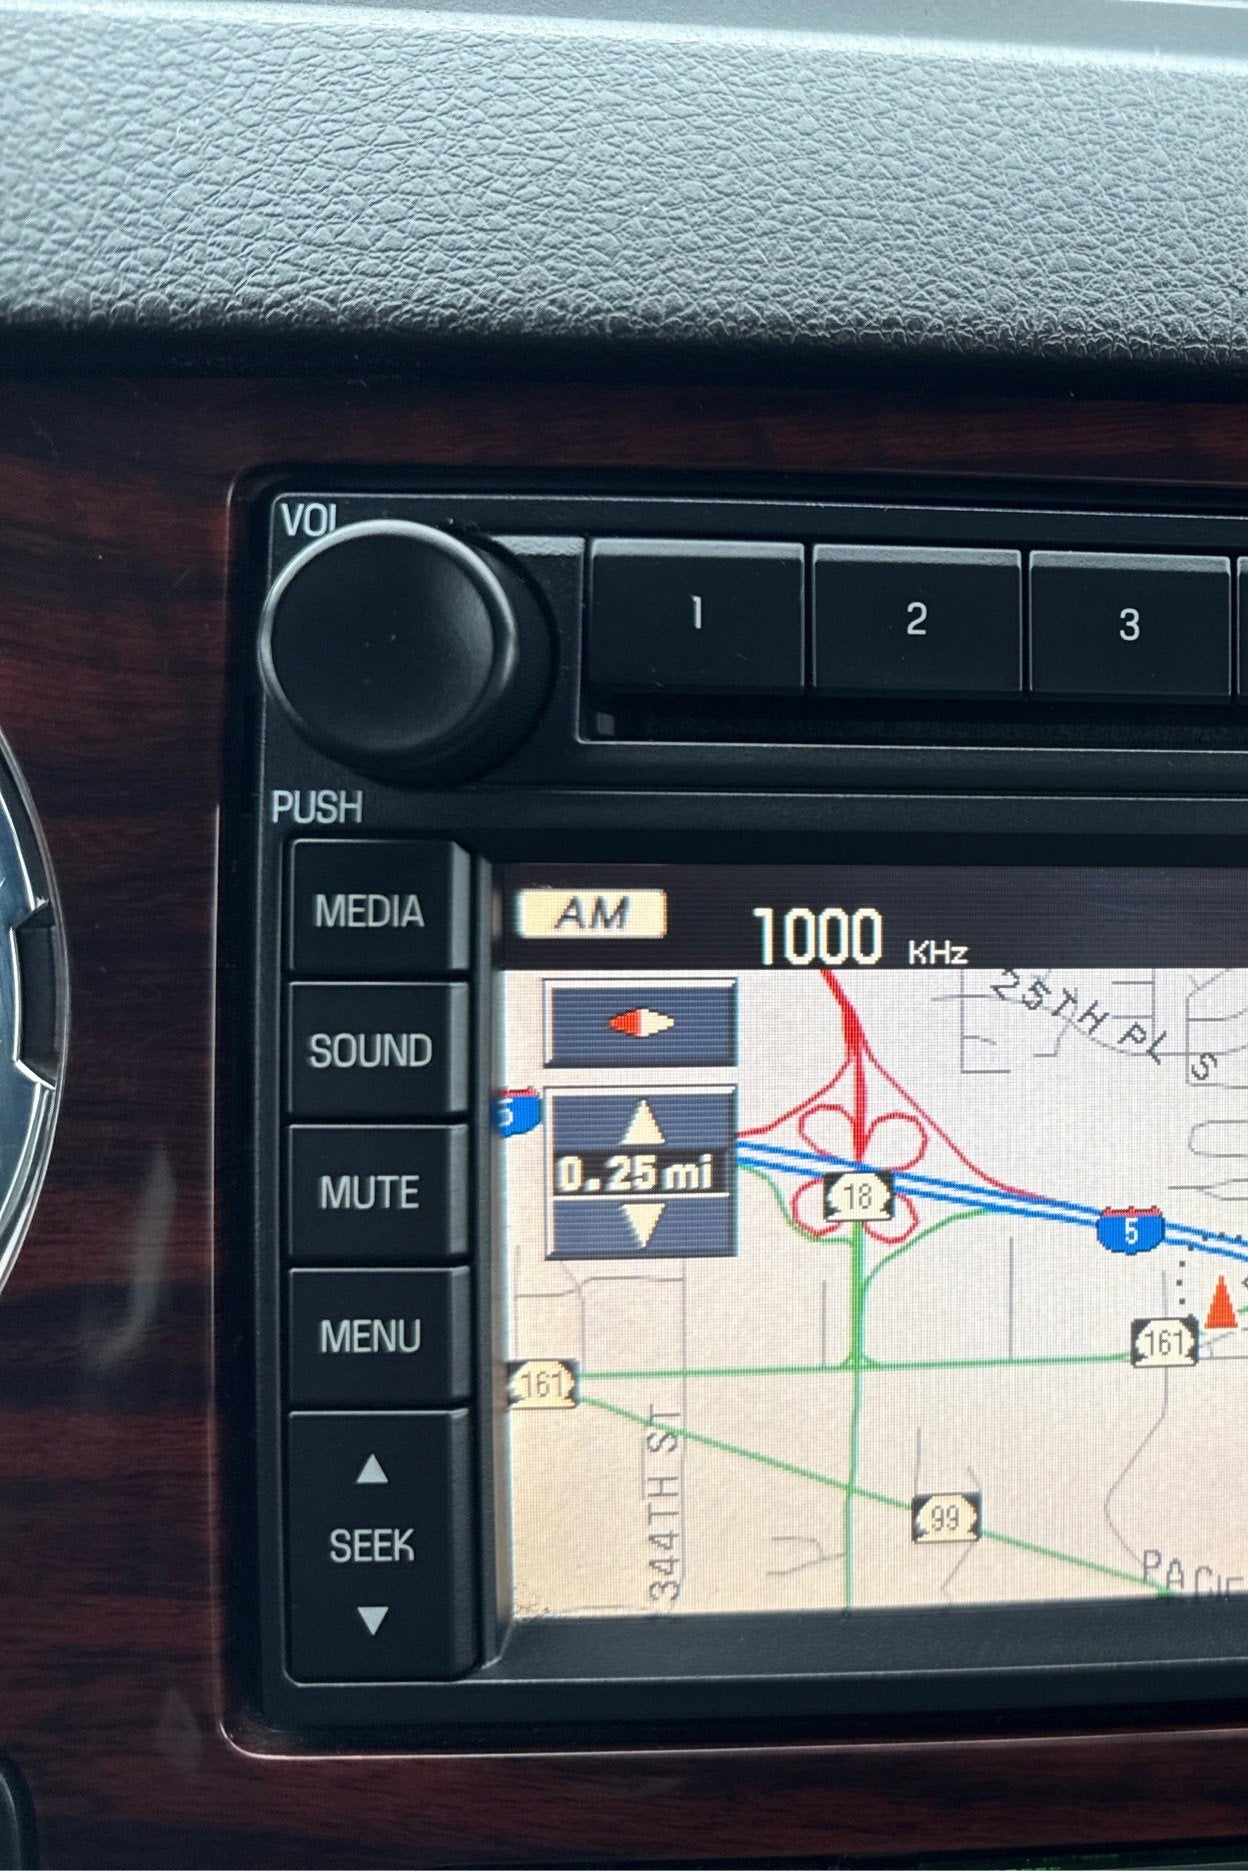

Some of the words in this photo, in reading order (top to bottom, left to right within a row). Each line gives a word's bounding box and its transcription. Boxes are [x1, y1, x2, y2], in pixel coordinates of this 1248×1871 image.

[691, 594, 702, 630] 1
[906, 601, 928, 636] 2
[1118, 607, 1141, 642] 3
[270, 790, 364, 825] PUSH
[315, 893, 426, 929] MEDIA
[554, 894, 632, 931] AM
[752, 906, 884, 966] 1000
[907, 939, 970, 966] KHz
[989, 967, 1110, 1035] 25TH
[1116, 1021, 1168, 1066] PL
[1191, 1052, 1218, 1081] S
[308, 1031, 434, 1069] SOUND
[320, 1174, 421, 1210] MUTE
[842, 1182, 873, 1210] 18
[1124, 1217, 1139, 1245] 5
[319, 1318, 422, 1355] MENU
[1144, 1330, 1186, 1357] 161
[520, 1369, 567, 1400] 161
[647, 1402, 683, 1454] ST
[930, 1505, 961, 1533] 99
[329, 1527, 416, 1563] SEEK
[646, 1475, 682, 1602] 344TH
